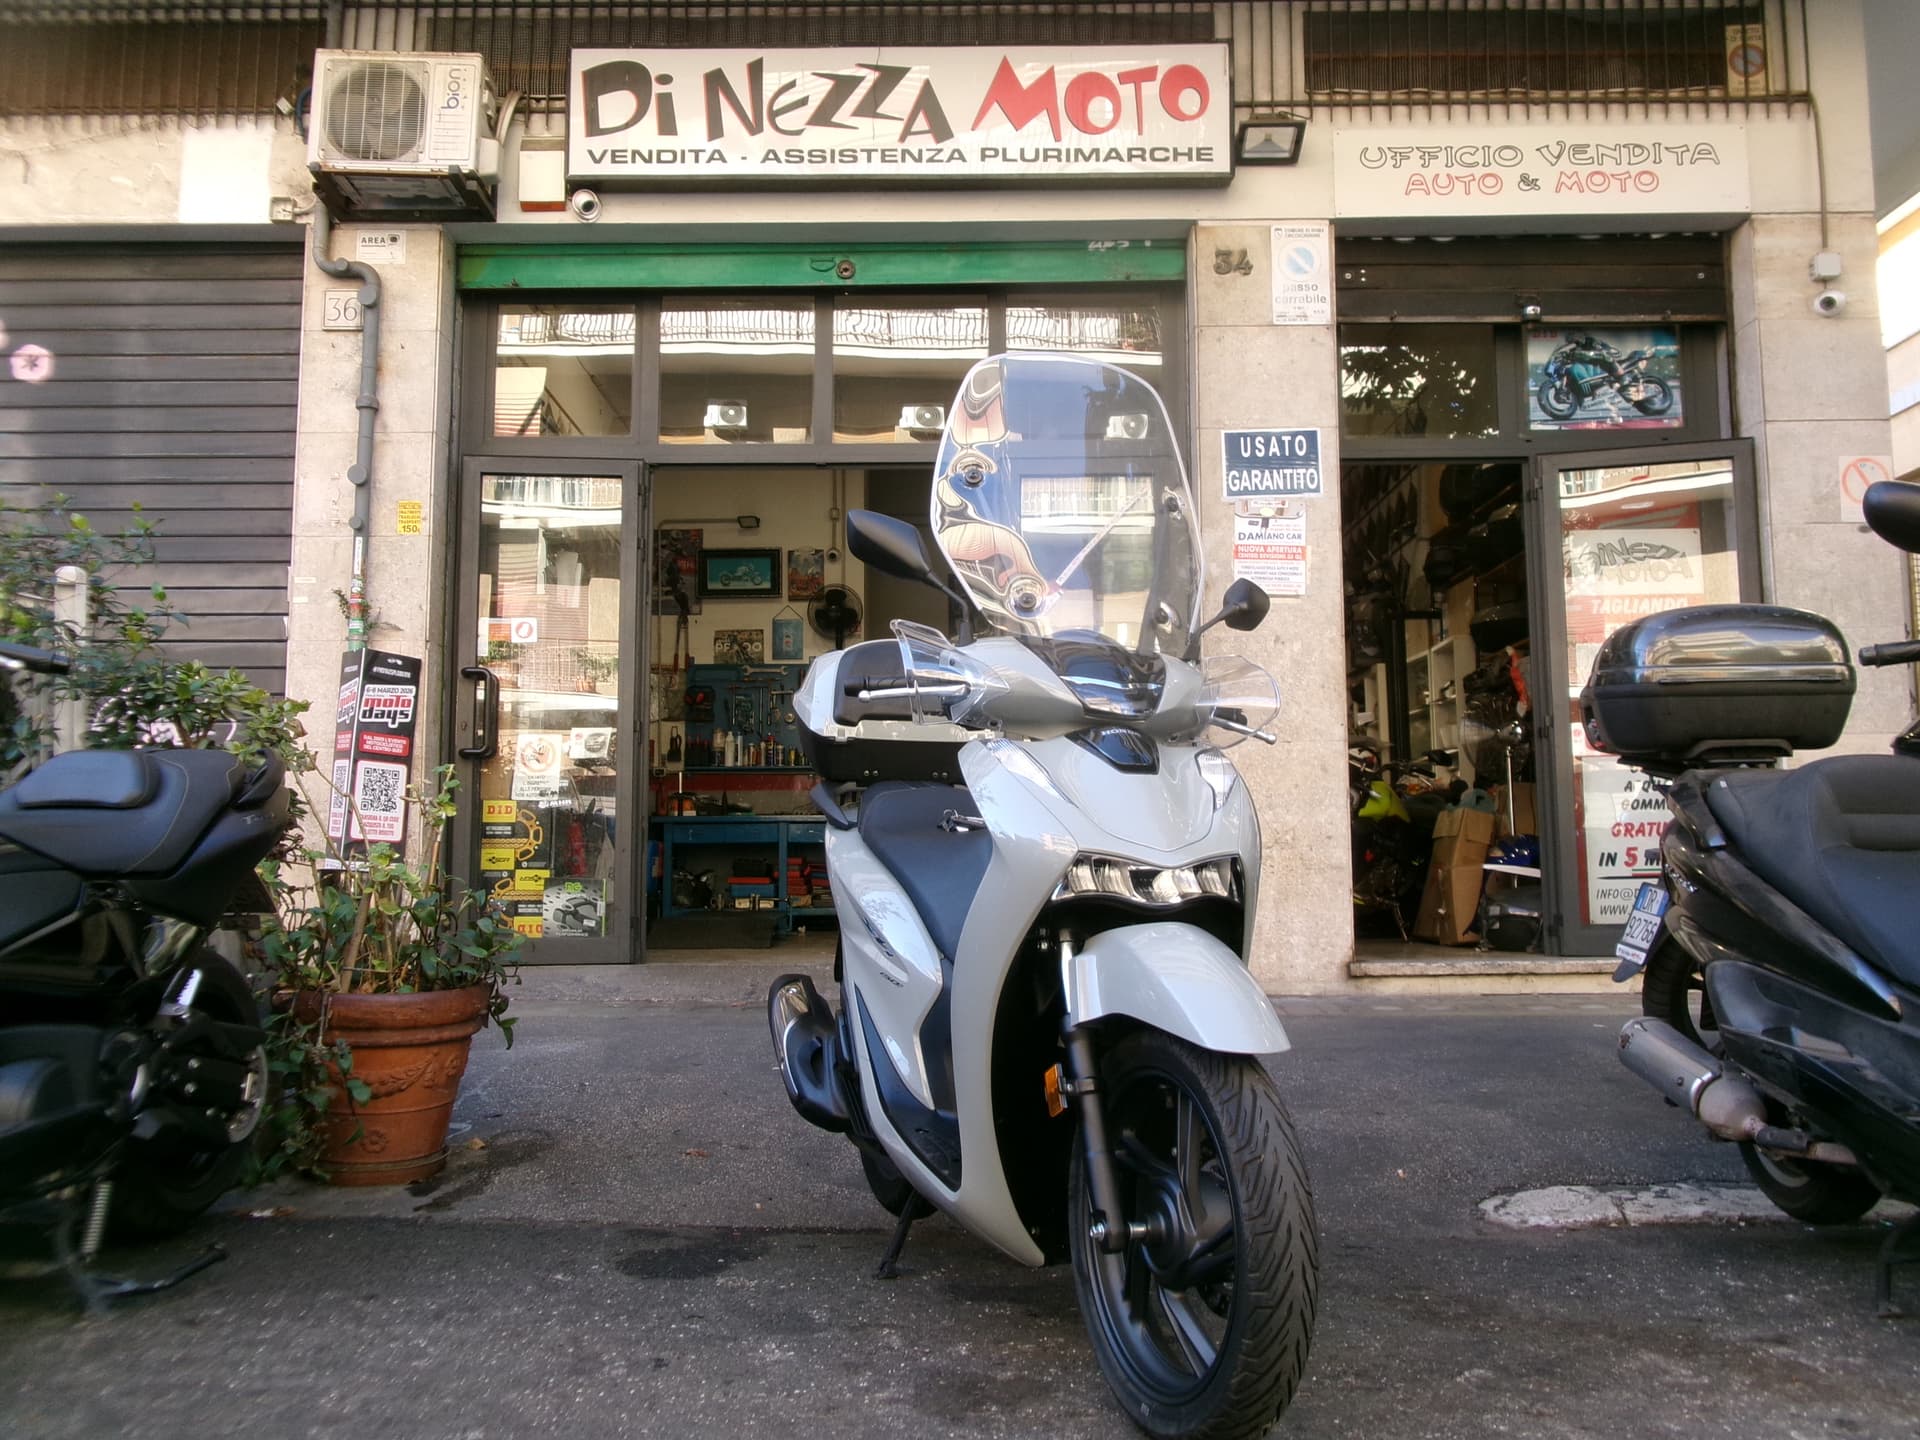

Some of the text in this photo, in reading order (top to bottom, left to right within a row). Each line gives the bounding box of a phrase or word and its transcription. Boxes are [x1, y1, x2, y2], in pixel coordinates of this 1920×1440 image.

[581, 60, 678, 138] Di
[970, 55, 1210, 143] MOTO
[586, 149, 728, 165] VENDITA
[760, 148, 968, 165] ASSISTENZA
[979, 146, 1214, 163] PLURIMARCHE
[1359, 140, 1721, 169] UFFICIO VENDITA
[1404, 170, 1660, 196] AUTO & MOTO
[361, 236, 386, 244] AREA
[1213, 248, 1254, 276] 34
[1274, 293, 1328, 305] carrabile
[1283, 283, 1319, 297] passo
[327, 297, 358, 322] 36
[1240, 435, 1307, 458] USATO
[1228, 468, 1318, 492] GARANTITO
[1238, 532, 1302, 541] DAMIANO CAR
[363, 695, 412, 708] moto
[361, 707, 410, 727] days
[487, 805, 513, 815] DID
[1598, 852, 1618, 868] IN
[1623, 847, 1639, 868] 5
[1625, 916, 1658, 944] 92766
